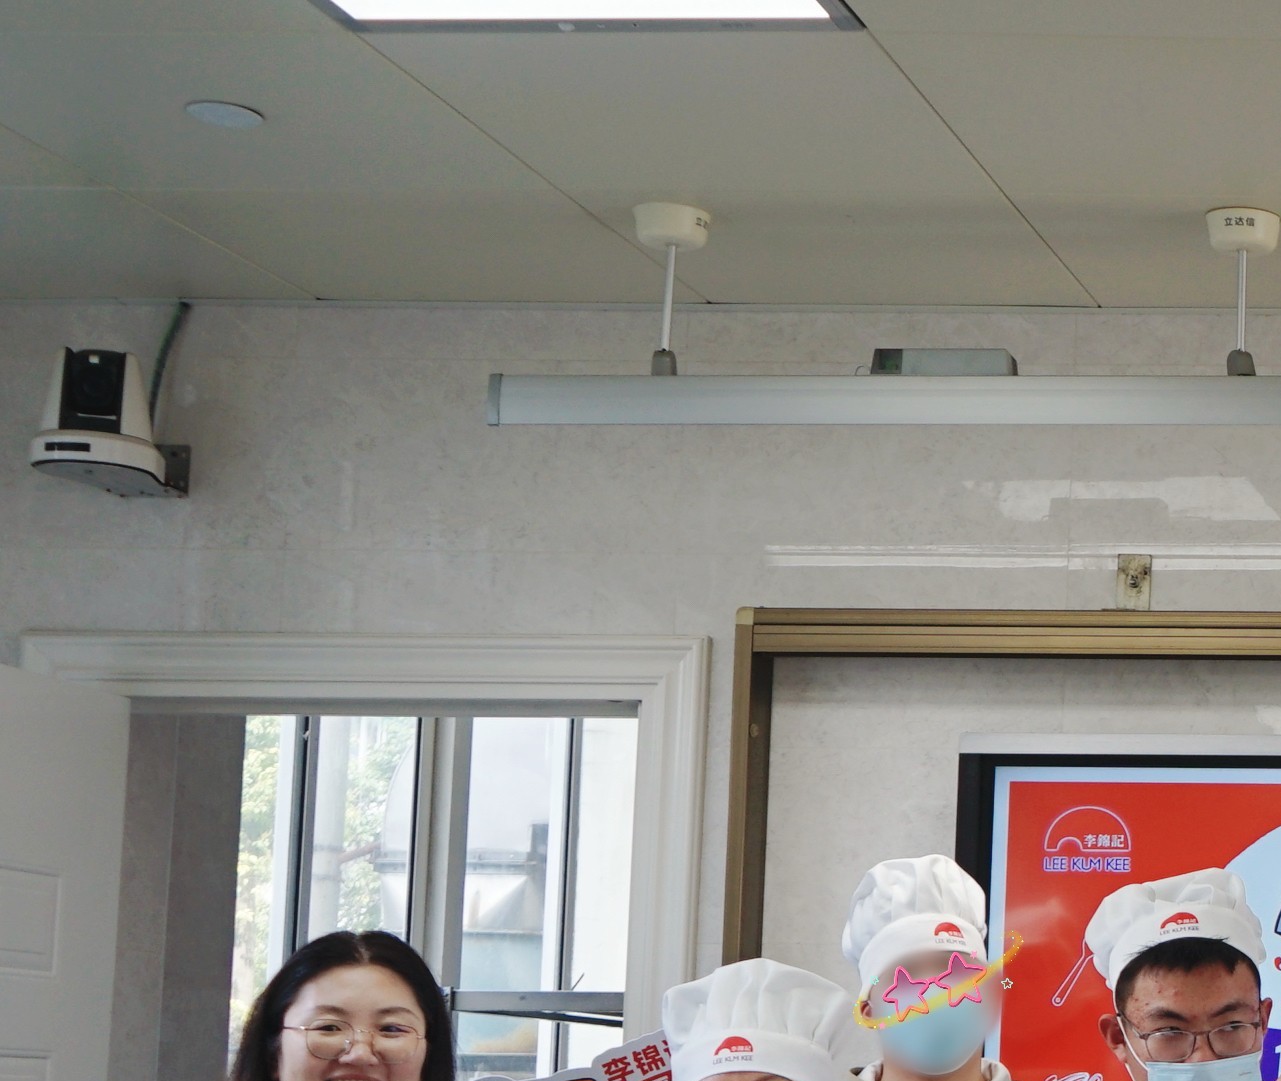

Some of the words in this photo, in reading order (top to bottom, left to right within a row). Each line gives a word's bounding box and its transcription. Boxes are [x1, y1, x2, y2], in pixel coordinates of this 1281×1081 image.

[1224, 216, 1255, 227] 立达信
[1083, 833, 1125, 848] 李錦記
[1044, 856, 1068, 872] LEE
[1071, 856, 1102, 872] KUM
[1105, 856, 1131, 872] KEE
